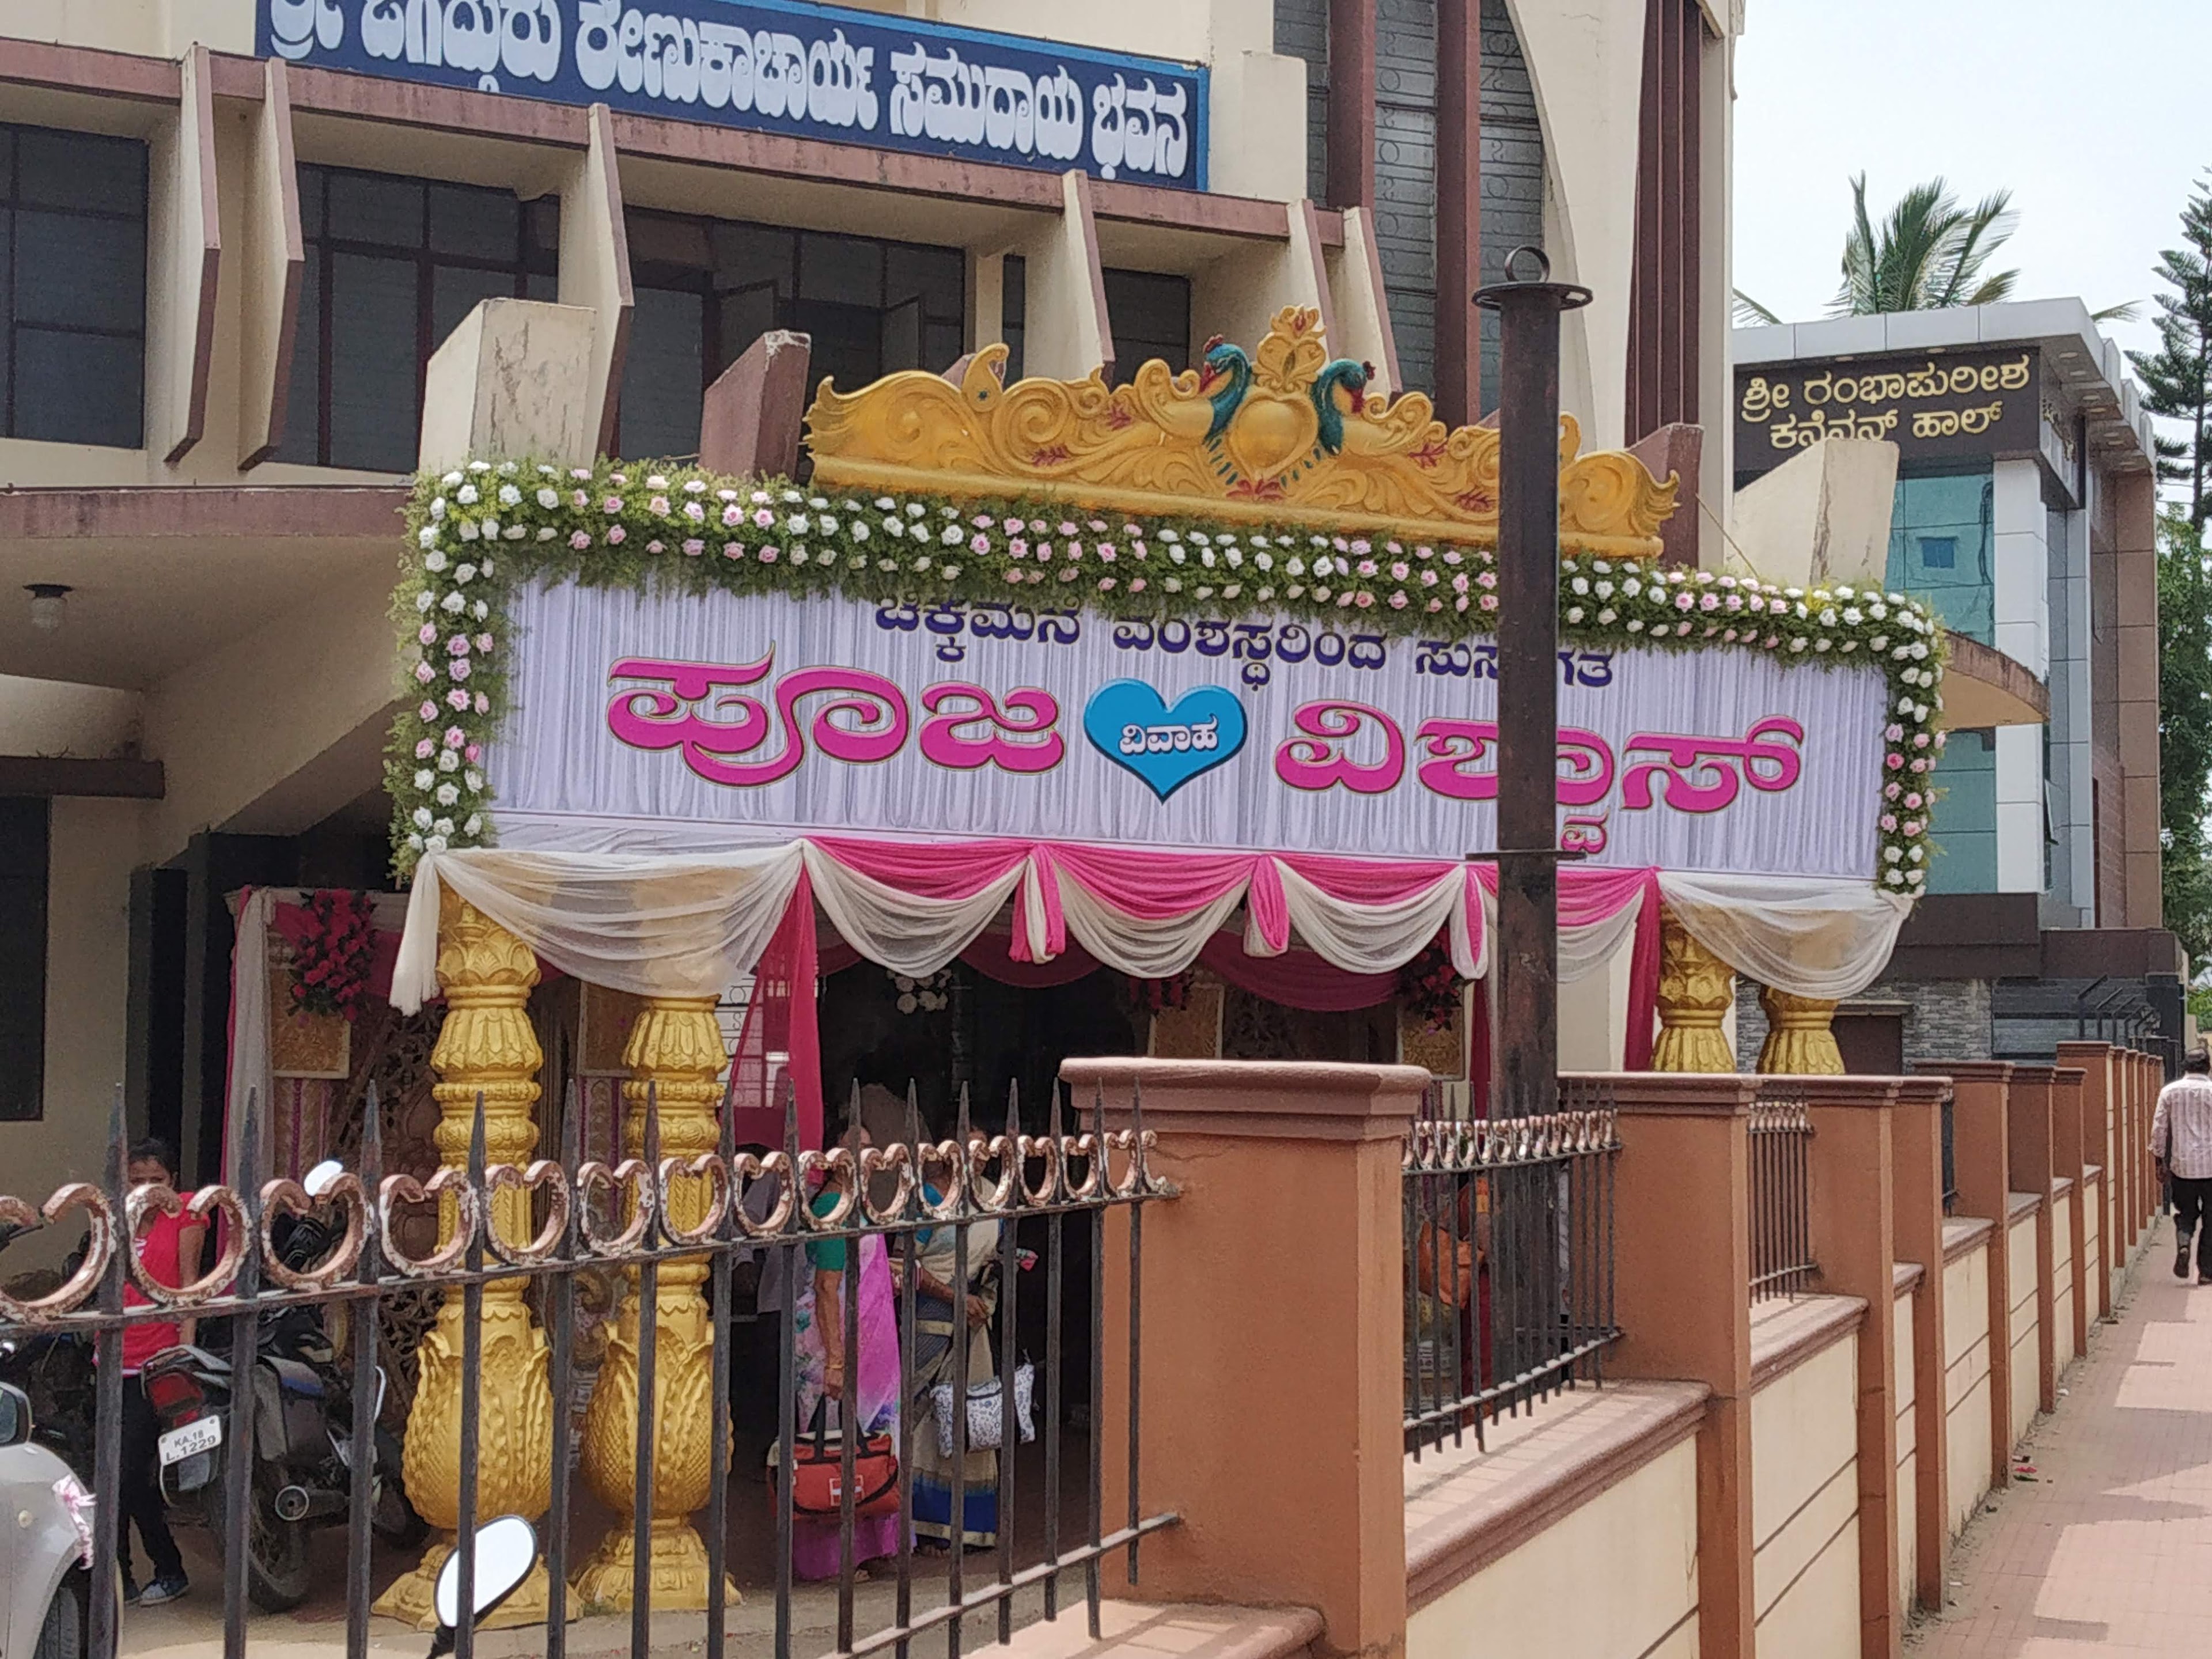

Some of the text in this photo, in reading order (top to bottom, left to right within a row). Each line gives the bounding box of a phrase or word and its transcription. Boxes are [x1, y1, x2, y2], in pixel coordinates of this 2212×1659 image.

[889, 41, 1083, 161] ಸಮುದಾಯ
[1092, 72, 1188, 180] ಭವನ
[1741, 354, 2031, 423] ಶ್ರೀ ರಂಭಾಪುರೀಶ
[1912, 400, 2003, 439] ಹಾಲ್
[606, 641, 1066, 788] ಪೂಜ
[1119, 713, 1219, 755] ವಿವಾಹ
